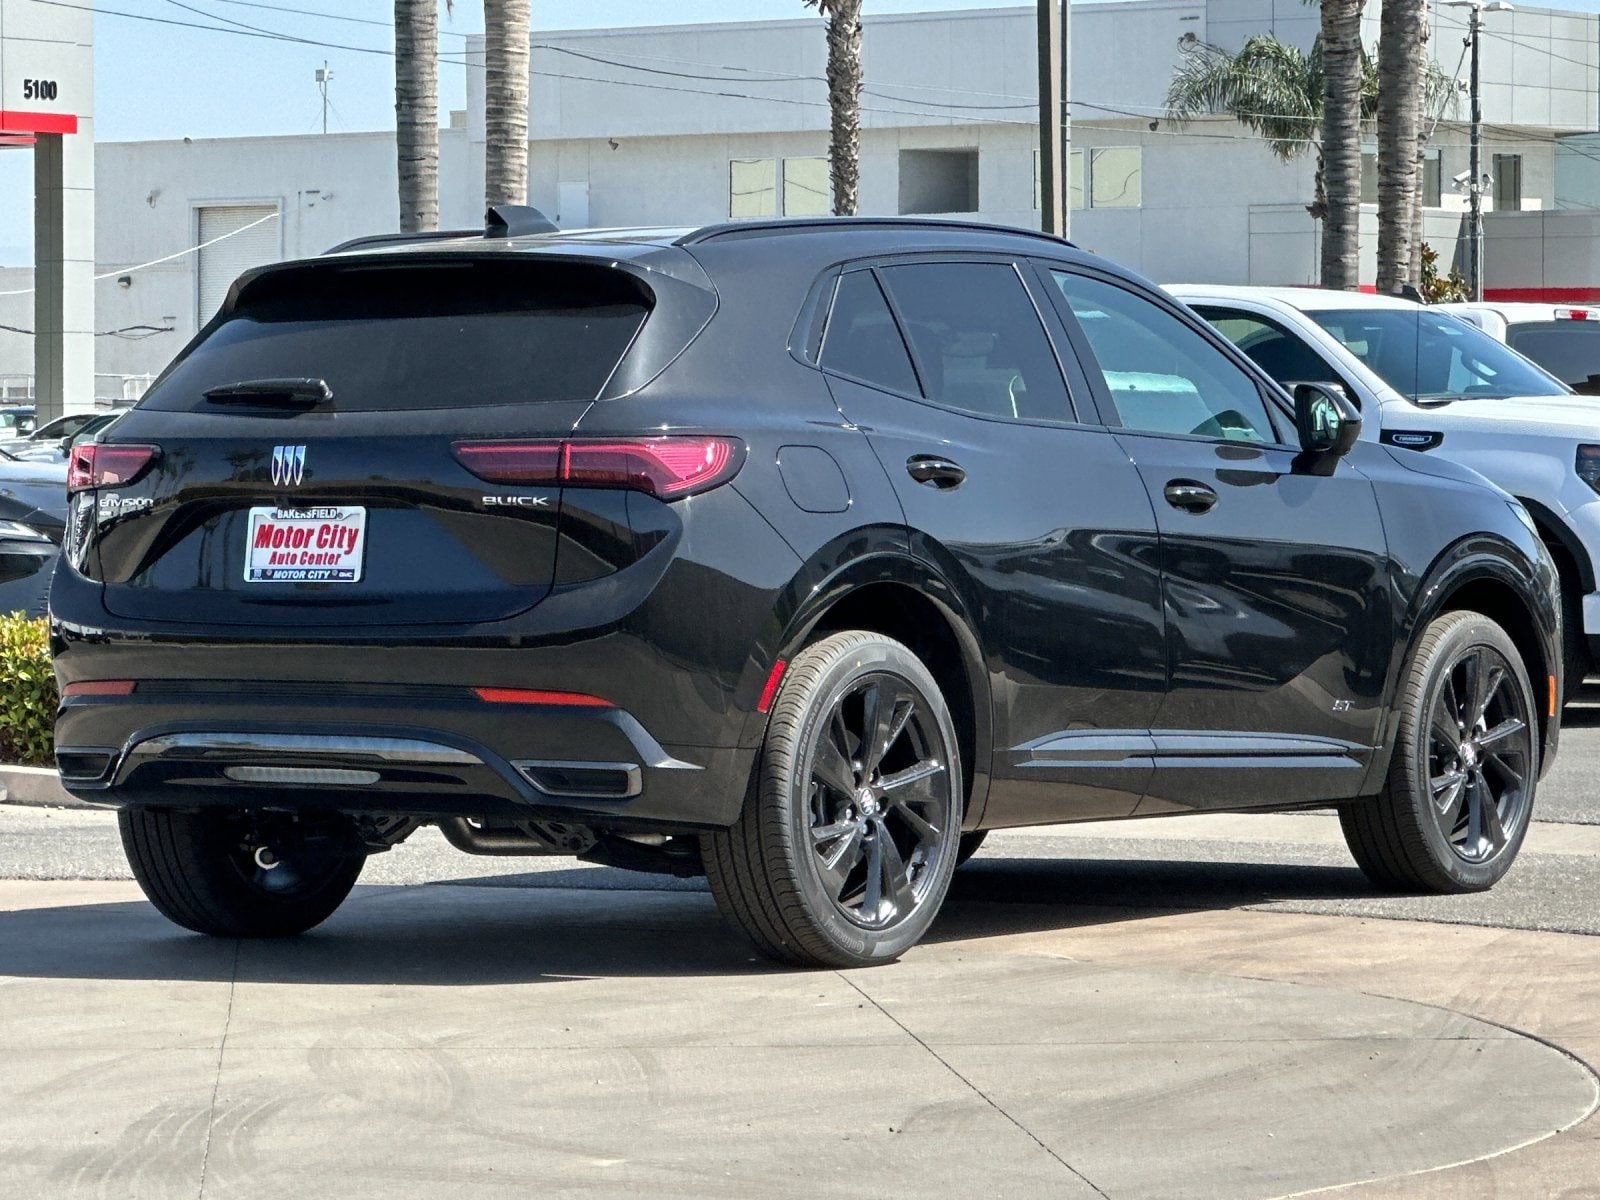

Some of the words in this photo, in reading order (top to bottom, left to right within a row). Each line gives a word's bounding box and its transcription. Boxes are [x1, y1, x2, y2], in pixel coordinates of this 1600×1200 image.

[23, 78, 58, 101] 5100
[482, 496, 549, 506] BUICK
[254, 524, 315, 549] Motor
[316, 523, 360, 555] City
[268, 551, 298, 565] Auto
[299, 551, 342, 565] Center
[272, 570, 305, 579] MOTOR
[307, 570, 331, 579] CITY
